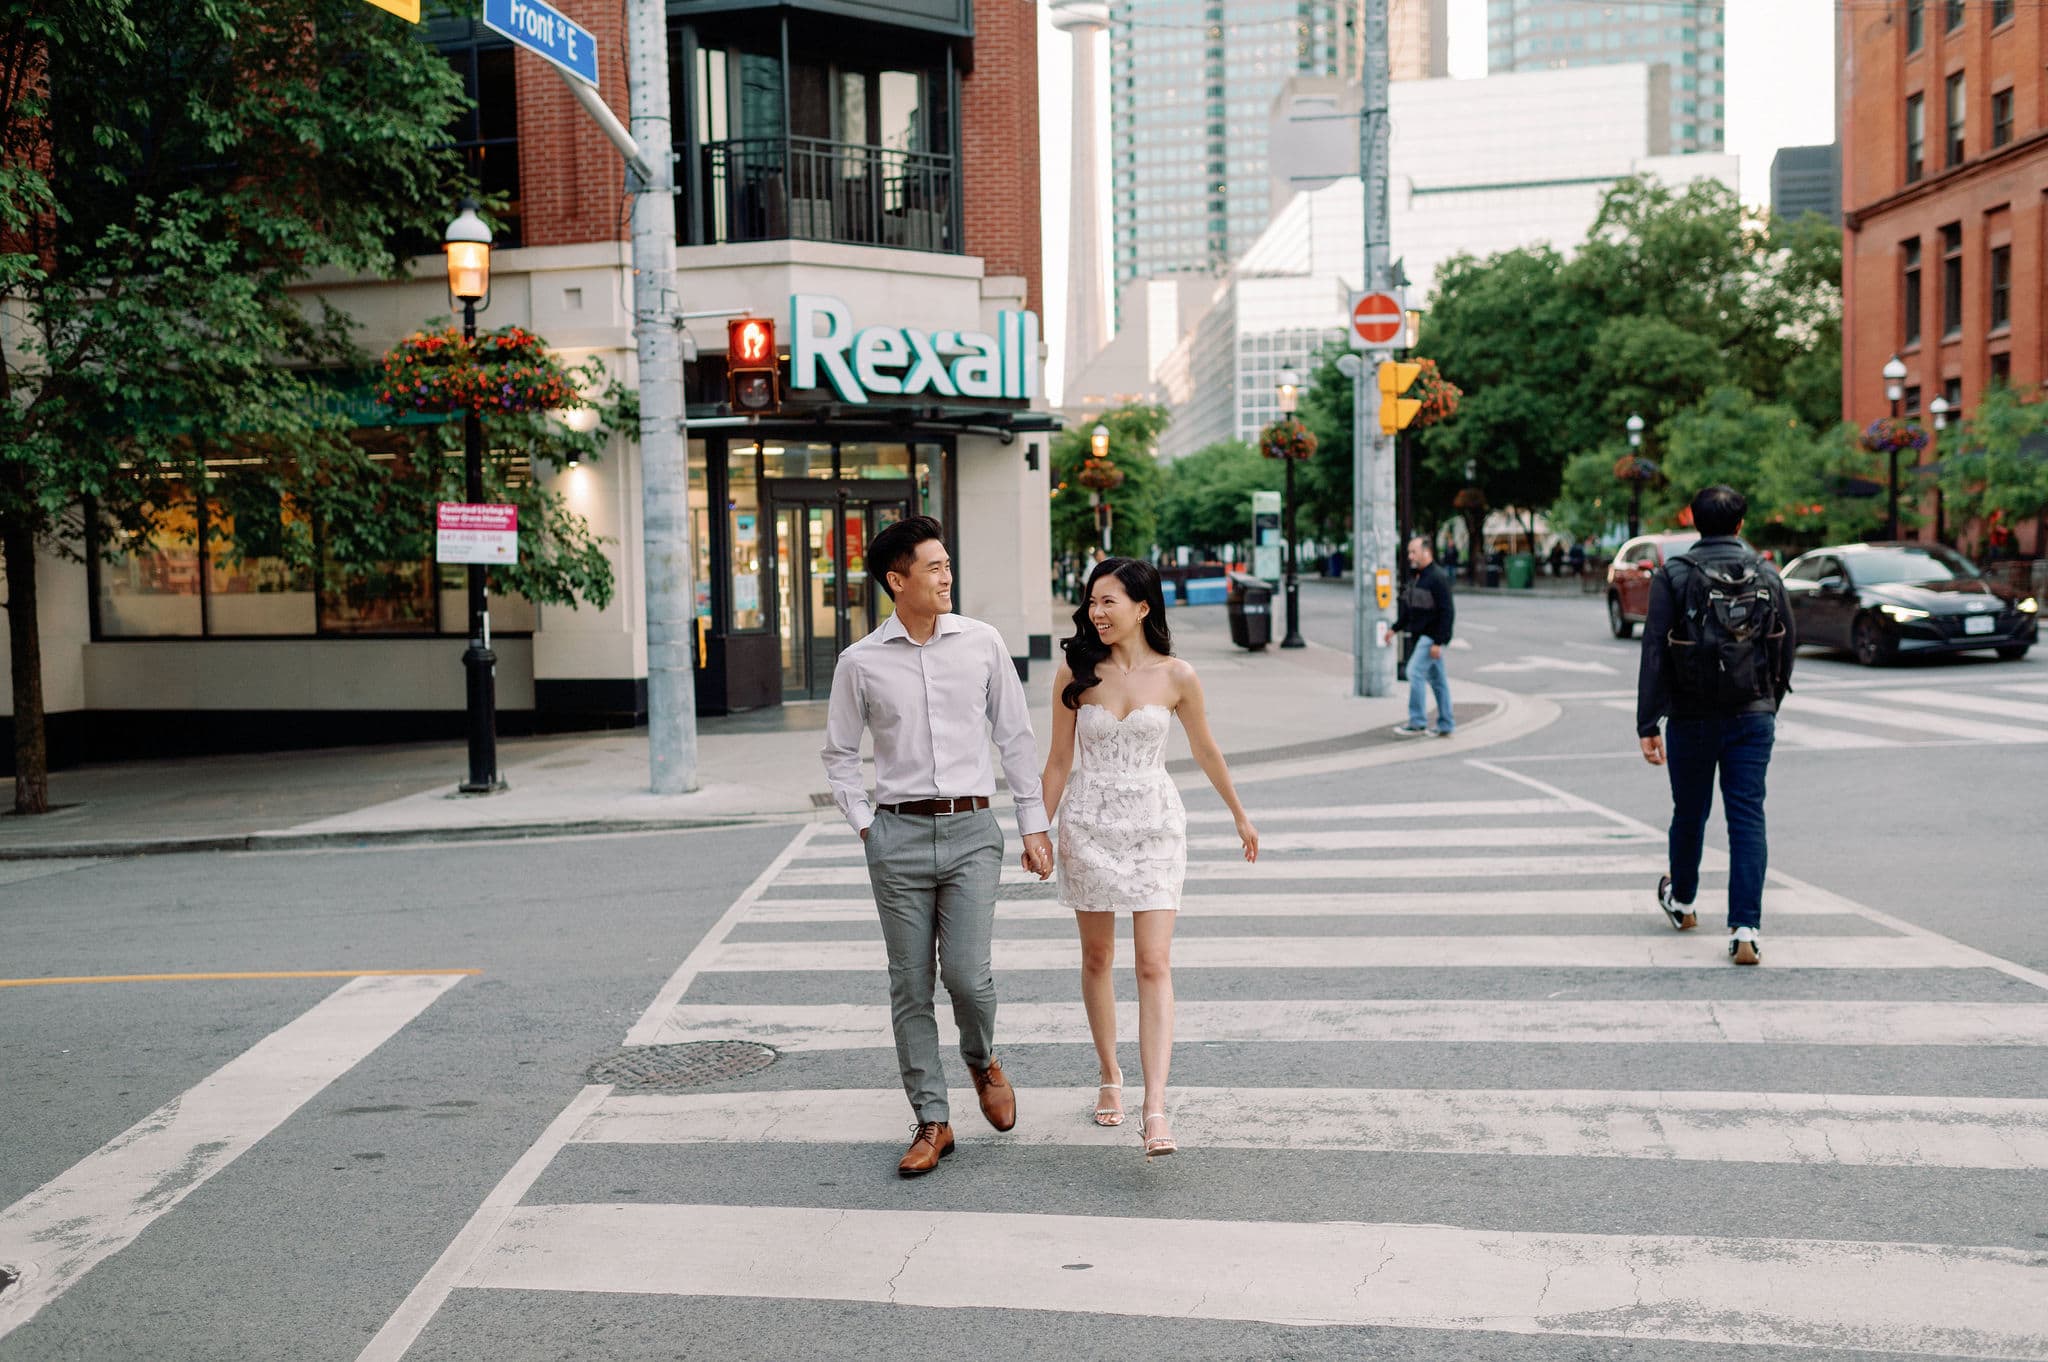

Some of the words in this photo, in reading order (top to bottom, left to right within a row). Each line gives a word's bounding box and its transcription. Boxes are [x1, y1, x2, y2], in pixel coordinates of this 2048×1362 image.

[510, 0, 554, 47] Front
[567, 27, 578, 61] E
[790, 294, 1039, 404] Rexall
[440, 514, 460, 522] Your
